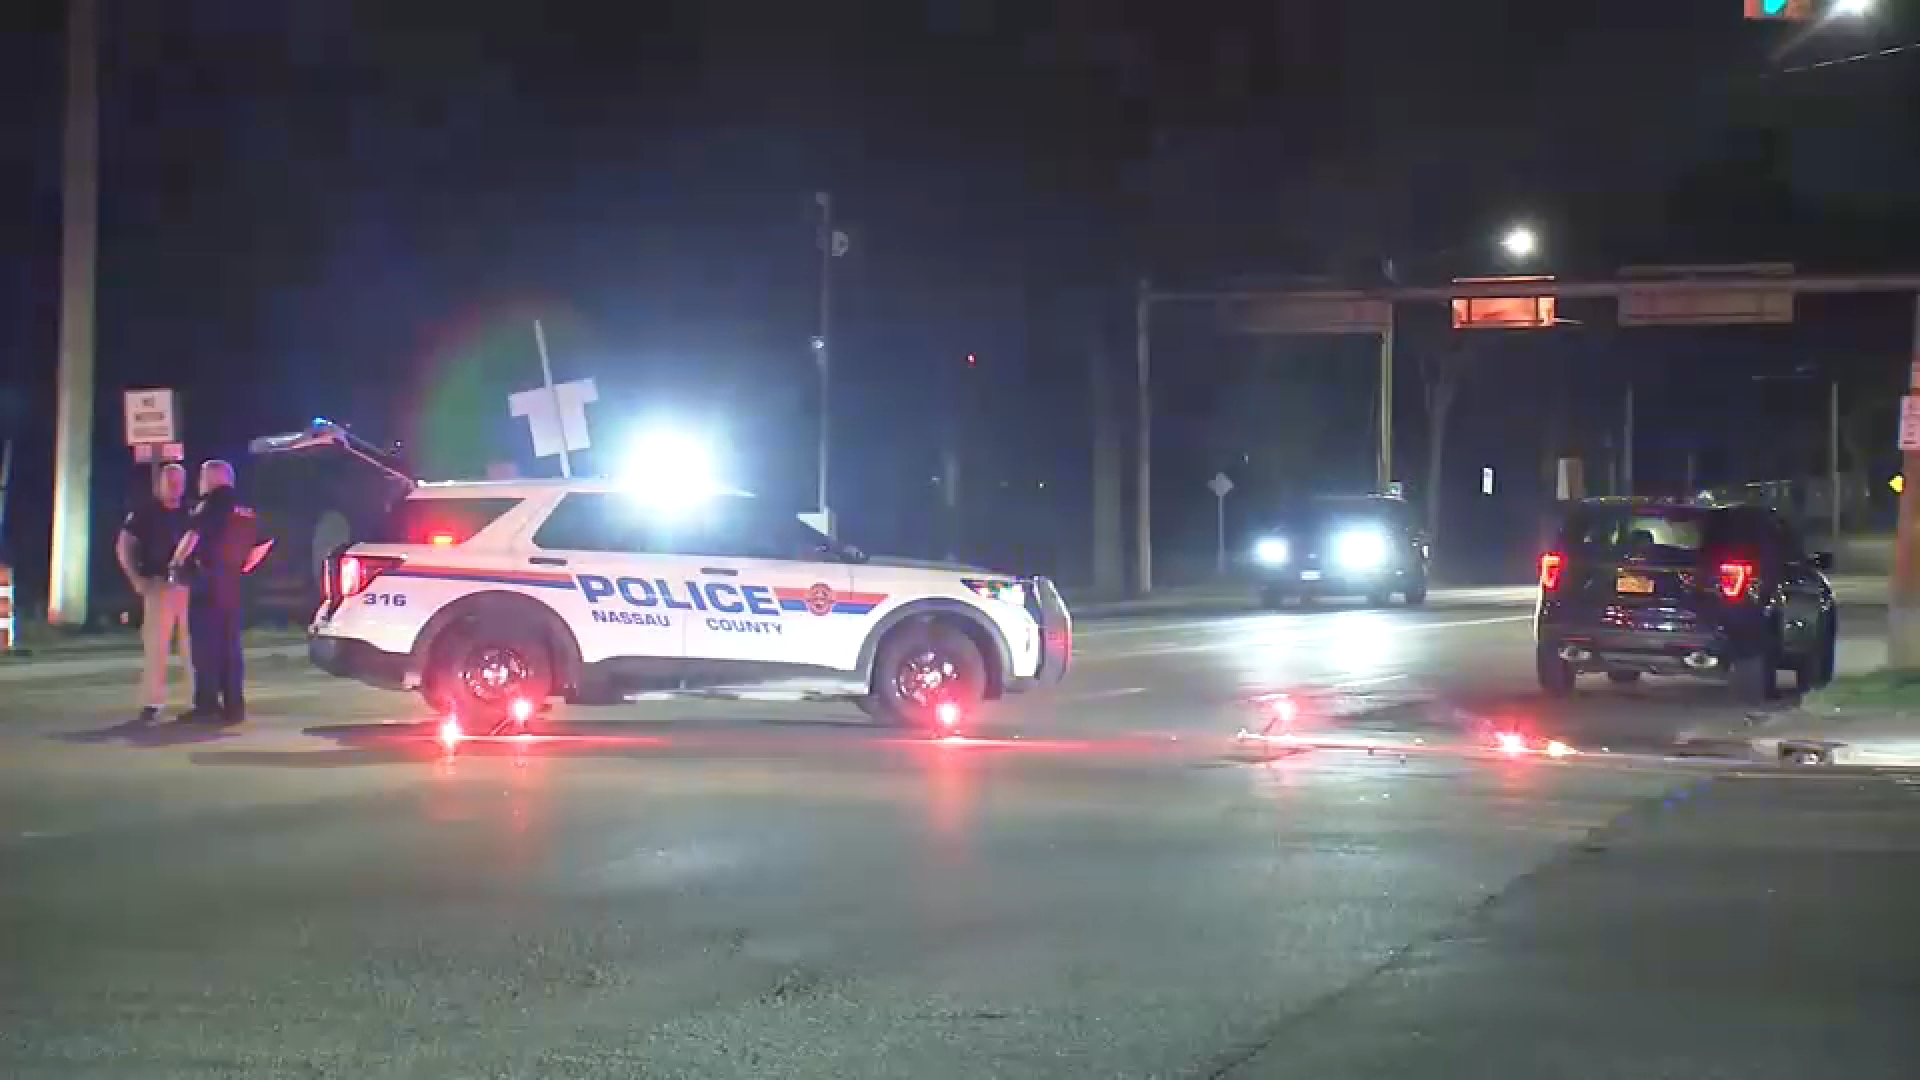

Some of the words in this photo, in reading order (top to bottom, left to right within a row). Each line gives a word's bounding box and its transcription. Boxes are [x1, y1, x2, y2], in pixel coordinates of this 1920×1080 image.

[363, 593, 406, 607] 316
[576, 574, 780, 616] POLICE
[591, 609, 671, 627] NASSAU
[705, 617, 783, 634] COUNTY
